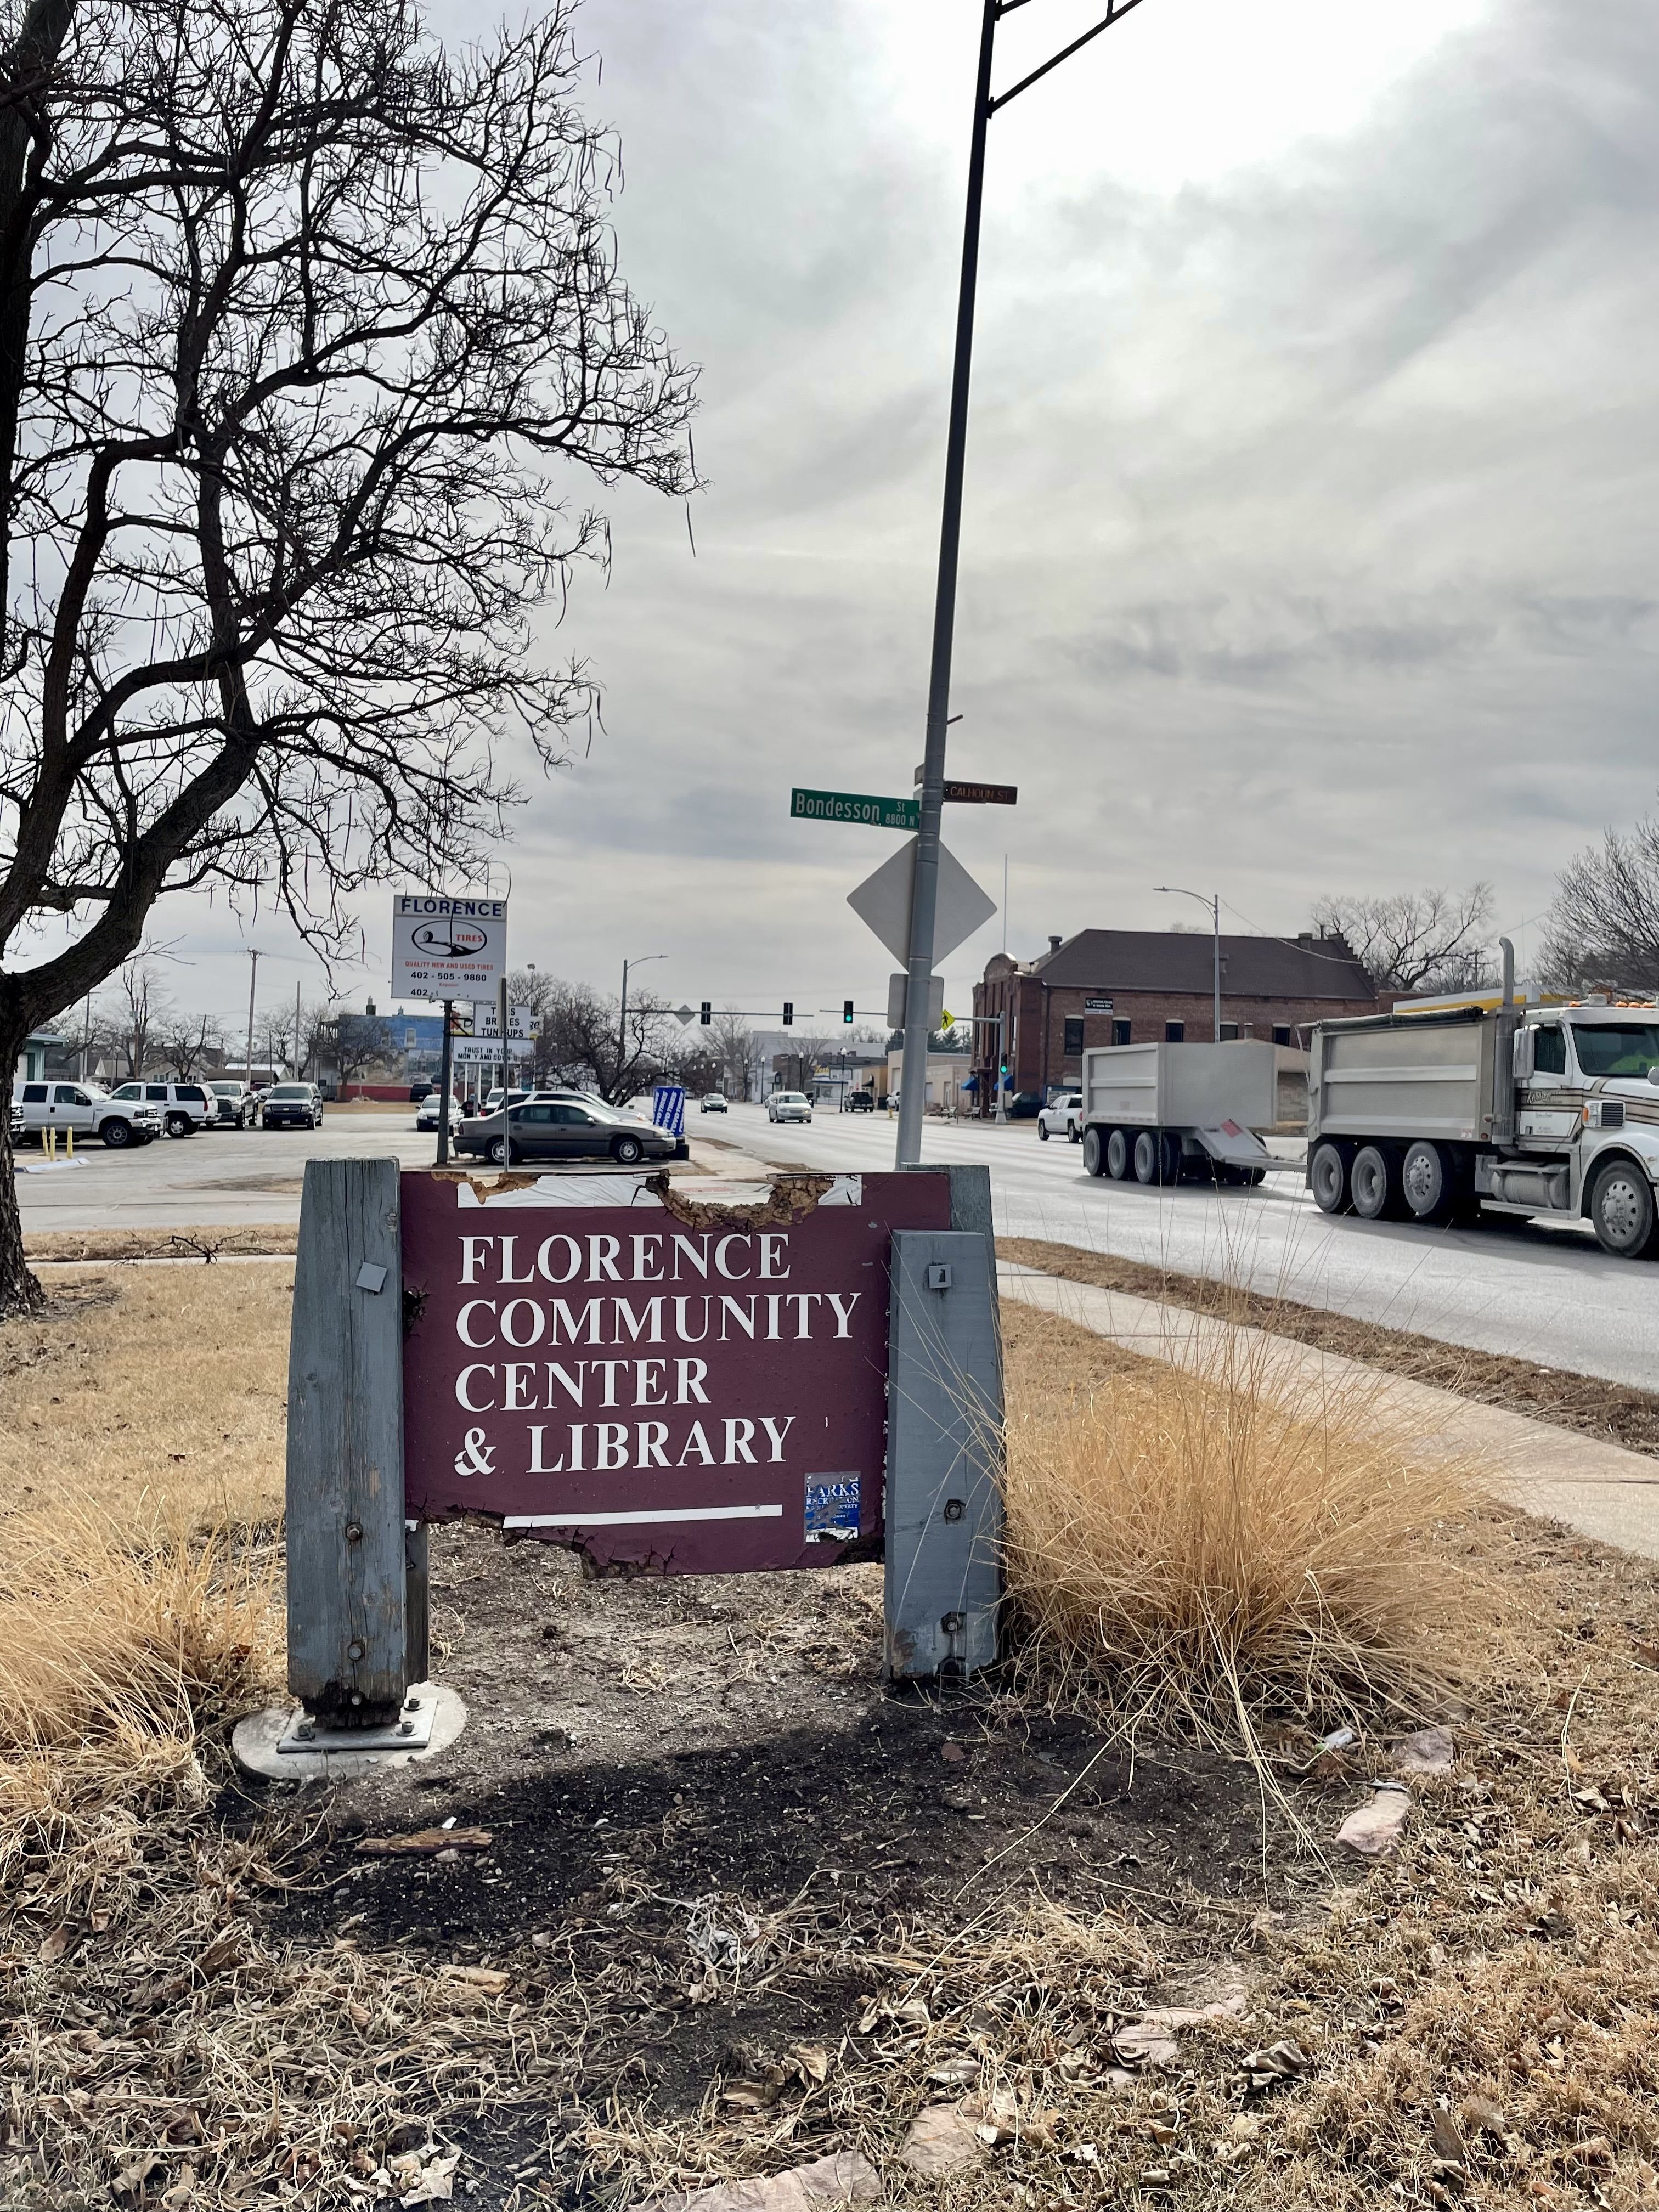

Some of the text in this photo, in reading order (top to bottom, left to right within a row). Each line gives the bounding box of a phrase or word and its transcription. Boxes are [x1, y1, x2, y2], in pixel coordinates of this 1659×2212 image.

[950, 786, 1010, 800] CALHOUN ST
[795, 793, 905, 821] Bondesson St
[885, 813, 915, 826] 8800 N
[402, 899, 501, 916] FLORENCE
[456, 934, 483, 942] TIRES
[486, 1017, 520, 1026] BRES
[457, 1234, 790, 1284] FLORENCE
[457, 1293, 861, 1347] COMMUNITY
[456, 1358, 711, 1412] CENTER
[455, 1417, 795, 1475] & LIBRARY
